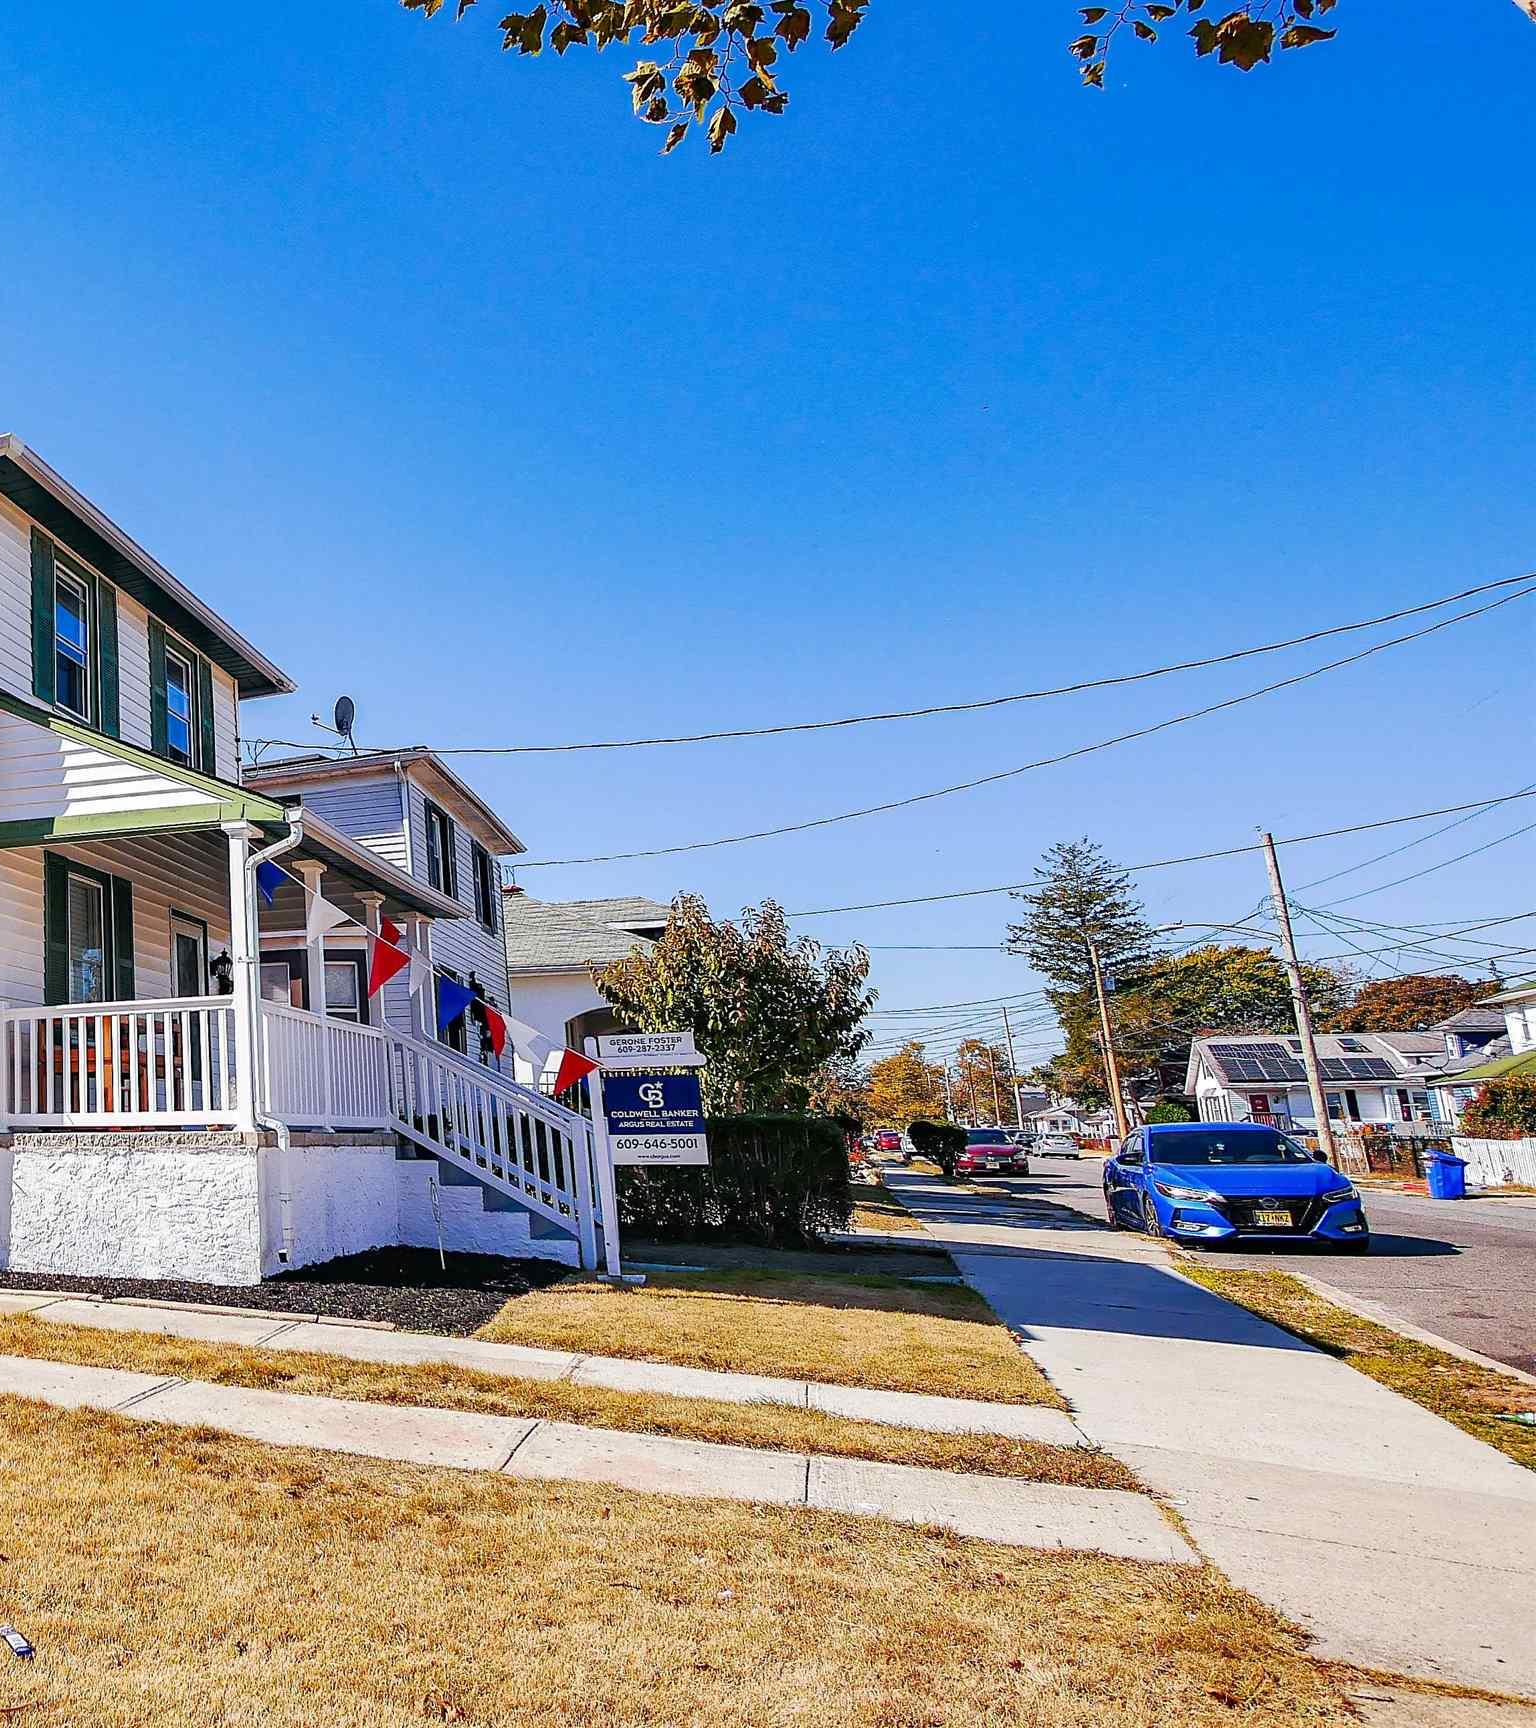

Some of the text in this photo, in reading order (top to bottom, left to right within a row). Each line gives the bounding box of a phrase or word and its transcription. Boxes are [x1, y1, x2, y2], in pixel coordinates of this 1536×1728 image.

[609, 1036, 682, 1046] GERONE FOSTER
[611, 1109, 699, 1118] COLDWELL BANKER
[616, 1138, 698, 1149] 609-646-5001
